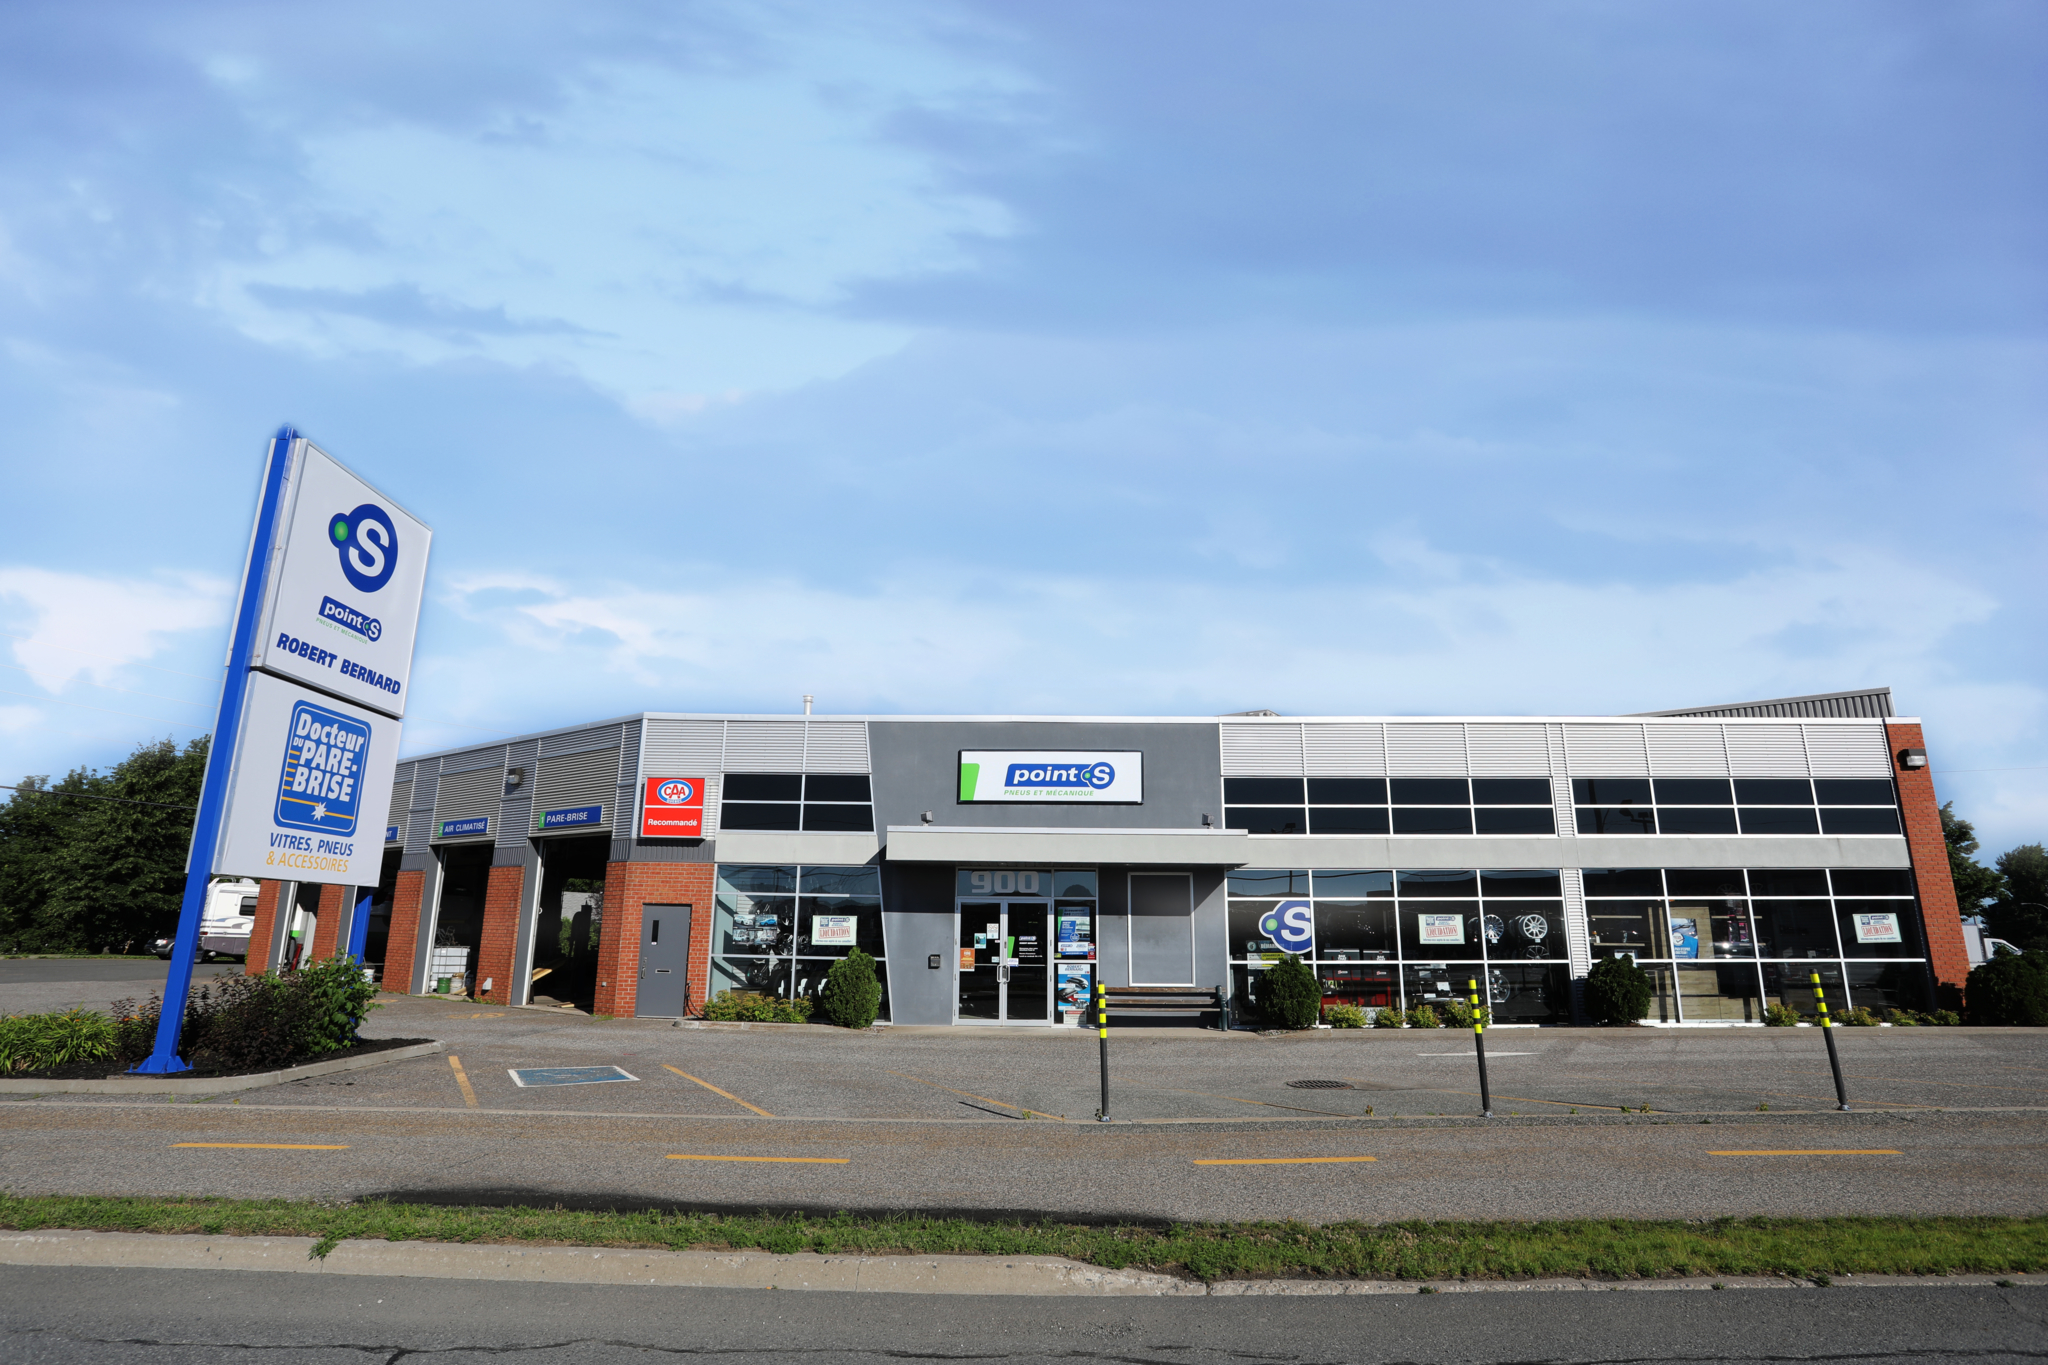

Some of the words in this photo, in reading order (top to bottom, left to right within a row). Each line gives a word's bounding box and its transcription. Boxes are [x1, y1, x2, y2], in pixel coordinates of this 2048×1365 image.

[349, 518, 390, 578] S
[315, 617, 333, 630] PNEUS
[333, 625, 340, 633] ET
[323, 602, 363, 630] point
[276, 632, 338, 669] ROBERT
[340, 658, 402, 695] BERNARD
[295, 712, 365, 753] Docteur
[293, 737, 304, 748] DU
[299, 739, 359, 776] PARE-
[292, 765, 355, 802] BRISE
[1012, 766, 1079, 785] point
[664, 784, 686, 799] CAA
[1045, 788, 1094, 797] MÉCANIQUE
[444, 823, 454, 833] AIR
[455, 820, 485, 833] CLIMATISÉ
[540, 816, 545, 825] 1
[546, 811, 588, 824] PARE-BRISE
[647, 818, 698, 827] Recommandé
[270, 832, 314, 853] VITRES,
[317, 839, 354, 857] PNEUS
[266, 850, 275, 866] &
[277, 852, 349, 873] ACCESSOIRES
[971, 870, 1039, 894] 900
